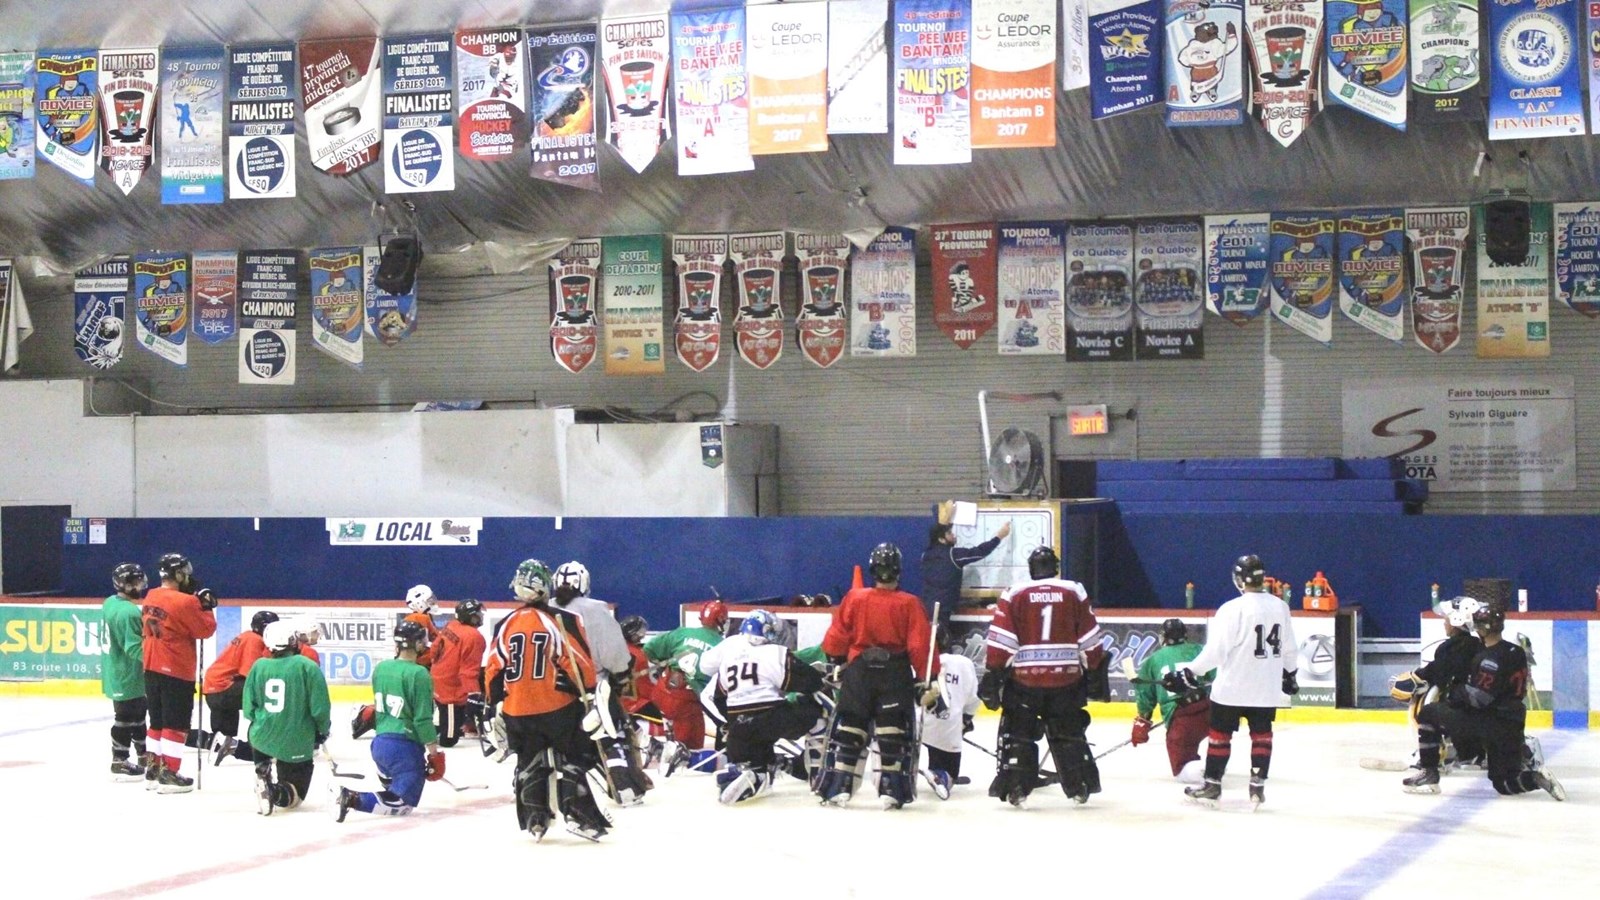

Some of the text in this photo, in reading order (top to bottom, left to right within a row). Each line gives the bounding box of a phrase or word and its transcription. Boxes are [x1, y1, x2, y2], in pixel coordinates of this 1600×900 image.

[997, 13, 1029, 23] Coupe
[1093, 12, 1158, 28] Tournoi Provincial
[1253, 14, 1316, 31] FIN DE SAISON
[606, 21, 664, 41] CHAMPIONS
[772, 22, 802, 32] Coupe
[898, 22, 945, 32] TOURNOI
[998, 25, 1051, 37] LEDOR
[461, 32, 517, 45] CHAMPION
[547, 33, 595, 45] Édition
[675, 35, 721, 46] TOURNOI
[772, 33, 822, 45] LEDOR
[919, 31, 967, 44] PEE WEE
[1331, 31, 1403, 46] NOVICE
[1421, 38, 1470, 49] CHAMPIONS
[388, 40, 449, 55] LIGUE COMPÉTITION
[482, 45, 497, 55] BB
[696, 42, 742, 57] PEE WEE
[902, 43, 963, 57] BANTAM
[997, 40, 1040, 48] Assurances
[104, 55, 154, 69] FINALISTES
[233, 49, 293, 63] LIGUE COMPÉTITION
[316, 50, 344, 73] tournoi
[401, 55, 434, 66] FRANC-SUD
[609, 50, 634, 66] FIN DE
[681, 54, 739, 70] BANTAM
[932, 56, 968, 65] WINDSOR
[185, 61, 221, 71] Tournoi
[247, 64, 278, 73] FRANC-SUD
[397, 64, 439, 77] DE QUÉBEC INC
[242, 73, 283, 84] DE QUÉBEC INC
[304, 55, 351, 93] provincial
[1105, 74, 1148, 83] Champions
[104, 80, 128, 93] FIN DE
[395, 77, 445, 89] SÉRIES 2017
[462, 80, 486, 91] 2017
[897, 67, 968, 95] FINALISTES
[238, 86, 287, 97] SÉRIES 2017
[304, 76, 341, 104] midget
[974, 87, 1052, 101] CHAMPIONS
[1110, 85, 1135, 93] Atome
[1169, 85, 1179, 101] A
[1509, 86, 1562, 99] CLASSE
[40, 100, 93, 110] NOVICE
[386, 94, 451, 113] FINALISTES
[476, 104, 506, 113] TOURNOI
[1103, 94, 1154, 114] Farnham 2017
[1435, 98, 1459, 107] 2017
[232, 102, 294, 120] FINALISTES
[472, 112, 511, 121] PROVINCIAL
[981, 105, 1044, 119] Bantam B
[1171, 108, 1239, 122] CHAMPIONS
[1262, 106, 1310, 120] NOVICE
[474, 120, 511, 132] HOCKEY
[1493, 115, 1581, 130] FINALISTES
[997, 123, 1028, 136] 2017
[1278, 120, 1294, 138] C
[470, 132, 514, 145] Bantam
[329, 144, 357, 165] classe
[342, 148, 370, 172] 2017
[534, 151, 579, 162] Bantam
[108, 160, 146, 170] NOVICE
[559, 163, 596, 176] 2017
[122, 172, 133, 187] A
[1408, 213, 1467, 229] FINALISTES
[1002, 228, 1050, 237] TOURNOI
[1071, 225, 1129, 236] Les Tournois
[1139, 223, 1199, 234] Les Tournois
[952, 230, 992, 240] TOURNOI
[1016, 236, 1060, 246] Provincial
[675, 239, 725, 254] FINALISTES
[732, 237, 783, 252] CHAMPIONS
[797, 234, 848, 250] CHAMPIONS
[940, 240, 988, 250] PROVINCIAL
[1222, 237, 1254, 247] 2011
[1088, 247, 1128, 257] Québec
[1156, 245, 1197, 255] Québec
[1571, 251, 1594, 260] HOCKEY
[246, 254, 295, 265] LIGUE COMPÉTITION
[618, 251, 649, 262] COUPE
[195, 260, 235, 268] CHAMPION
[607, 262, 661, 276] DESJARDINS
[1273, 262, 1331, 273] NOVICE
[1342, 260, 1401, 272] NOVICE
[138, 296, 184, 307] NOVICE
[201, 308, 227, 318] 2017
[242, 302, 295, 316] CHAMPIONS
[1141, 317, 1200, 330] Finaliste
[954, 329, 976, 340] 2011
[1146, 335, 1194, 346] Novice A
[1076, 336, 1124, 348] Novice C
[1448, 388, 1550, 398] Faire toujours mieux
[1449, 409, 1528, 419] Sylvain Giguère
[1071, 416, 1105, 433] SORTIE
[375, 522, 433, 541] LOCAL
[1029, 592, 1063, 603] DROUIN
[1305, 587, 1322, 596] G G
[1311, 599, 1319, 608] G
[1041, 604, 1053, 641] 1
[1, 614, 103, 656] SUBW
[1254, 623, 1282, 659] 14
[13, 662, 26, 671] 83
[31, 663, 60, 672] route
[67, 664, 90, 674] 108,
[726, 662, 759, 692] 34
[265, 679, 286, 713] 9
